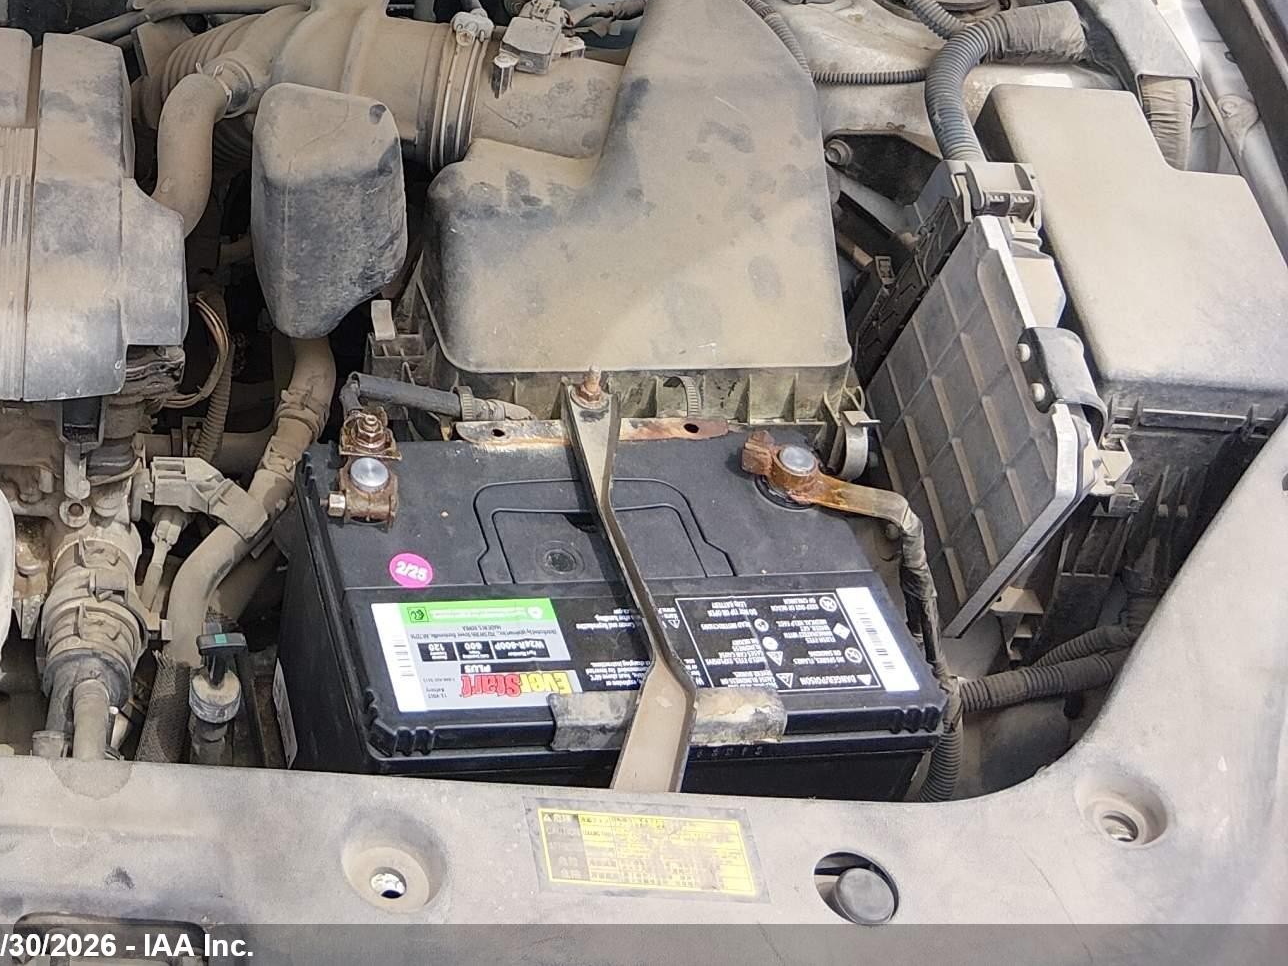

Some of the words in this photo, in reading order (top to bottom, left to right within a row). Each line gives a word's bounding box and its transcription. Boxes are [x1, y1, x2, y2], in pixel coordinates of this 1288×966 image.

[395, 560, 428, 582] 2/25
[429, 643, 444, 651] 120
[464, 642, 482, 650] 600
[464, 664, 491, 672] PLUS
[461, 672, 572, 697] EverStart
[800, 675, 857, 685] DANGER/POISON
